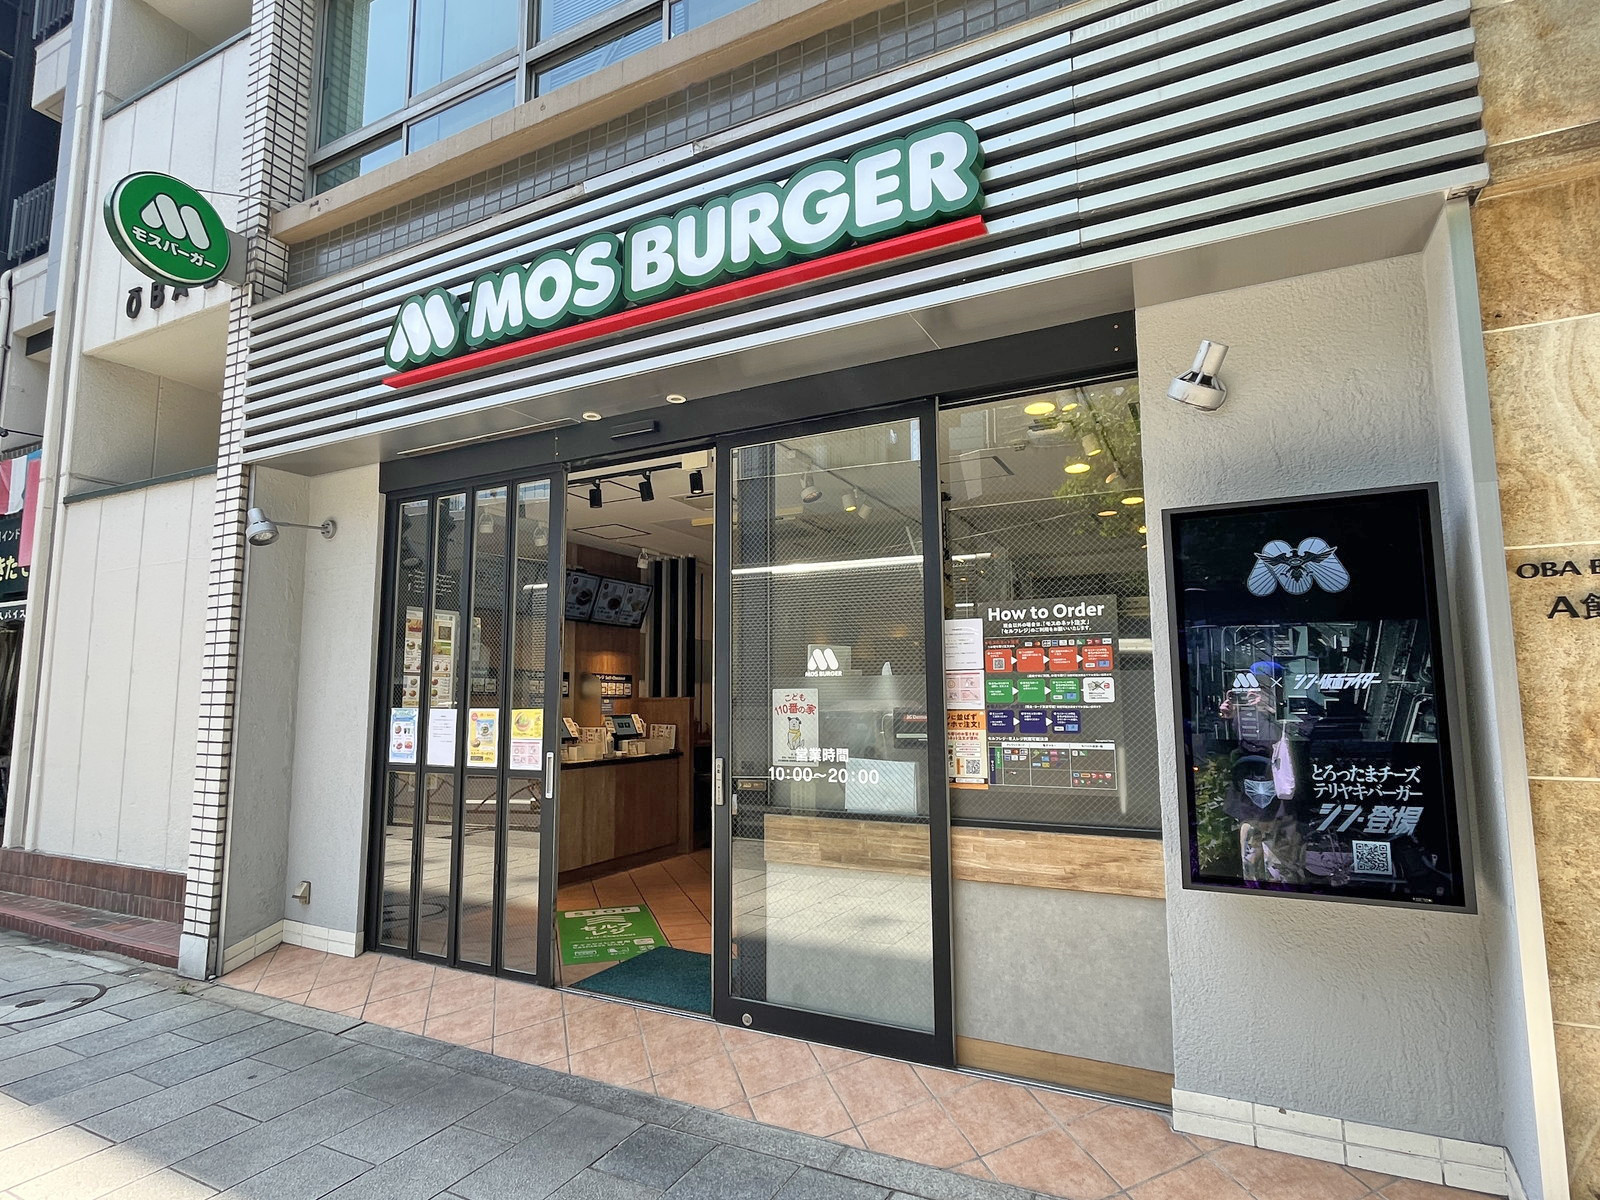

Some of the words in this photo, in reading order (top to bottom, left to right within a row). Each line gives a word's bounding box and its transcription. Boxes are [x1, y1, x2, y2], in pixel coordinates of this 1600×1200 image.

[471, 240, 617, 339] MOS
[630, 132, 968, 292] BURGER
[132, 226, 217, 268] モスバーガー
[1516, 560, 1582, 579] OBA
[987, 607, 1027, 621] How
[1030, 606, 1049, 619] to
[1053, 602, 1105, 618] Order
[784, 693, 806, 702] こども
[774, 703, 817, 716] 110番の家
[795, 747, 849, 763] 営業時間
[1311, 763, 1421, 783] とろったまチーズ
[1313, 782, 1424, 801] テリヤキバーガー
[1316, 803, 1425, 836] シン・登場
